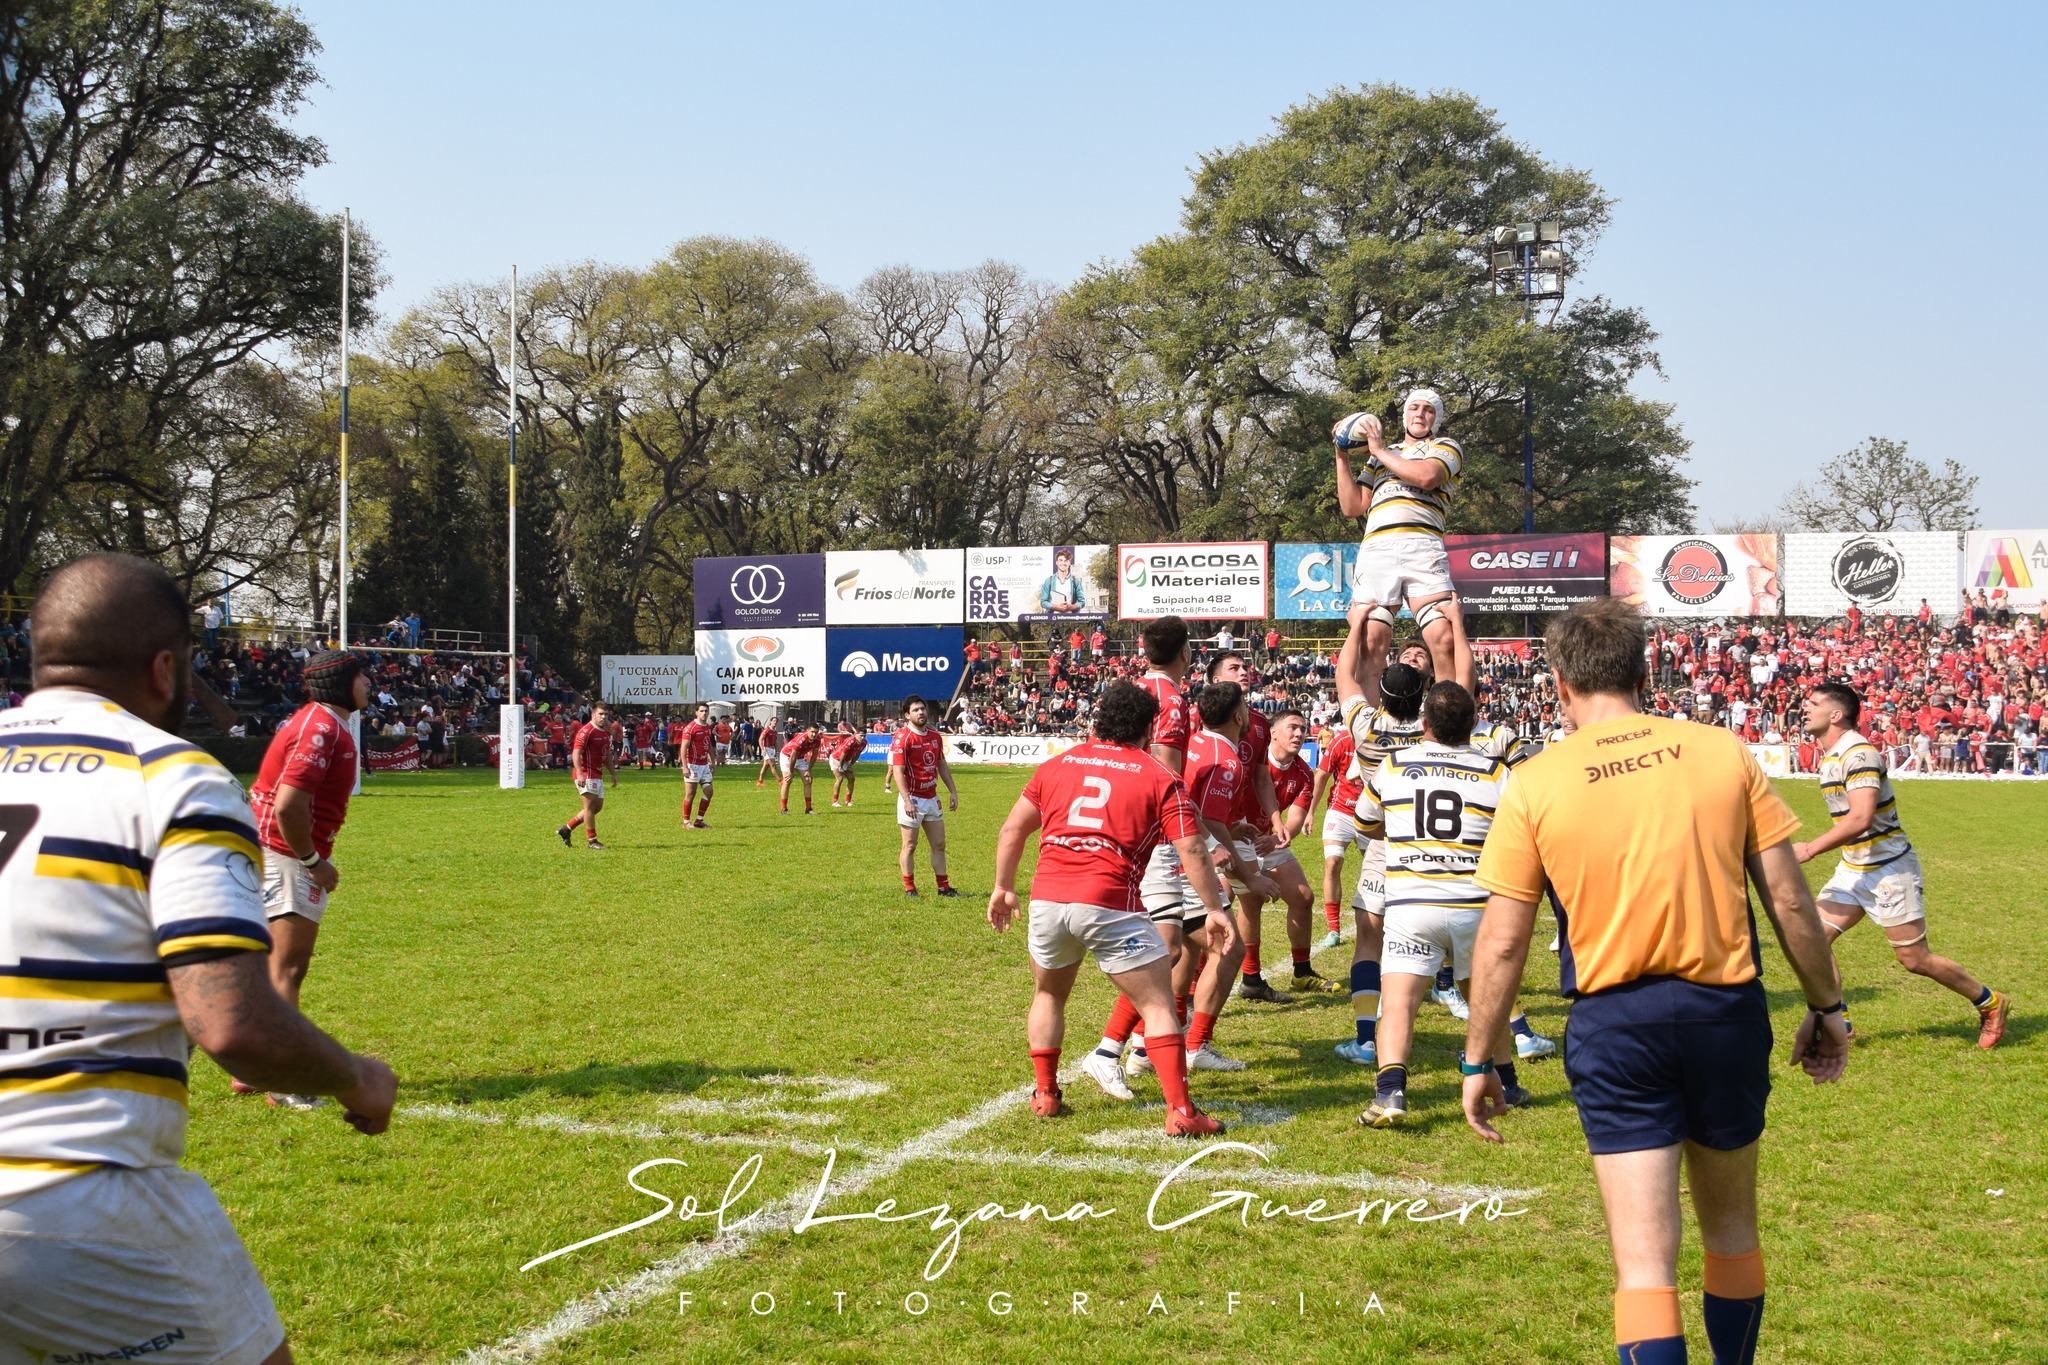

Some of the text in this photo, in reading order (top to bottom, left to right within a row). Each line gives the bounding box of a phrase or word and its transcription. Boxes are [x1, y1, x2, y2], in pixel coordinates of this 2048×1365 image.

[1673, 540, 1718, 554] PANIFICACION
[1150, 553, 1259, 569] GIACOSA
[1469, 550, 1551, 570] CASE
[1652, 564, 1735, 583] Las Delicias
[1840, 555, 1895, 586] Heller
[969, 575, 998, 590] CA
[1151, 573, 1260, 587] Materiales
[969, 590, 1009, 605] RRE
[1491, 586, 1536, 595] PUEBLE
[1152, 594, 1232, 606] Suipacha 482
[1298, 599, 1326, 612] LA
[1509, 596, 1522, 604] Km.
[1543, 596, 1566, 605] Parque
[735, 607, 782, 616] GOLOD Group
[969, 604, 1011, 619] RAS
[618, 664, 679, 676] TUCUMÁN
[882, 653, 950, 672] Macro
[716, 666, 805, 680] CAJA POPULAR
[641, 677, 657, 686] ES
[721, 683, 800, 695] DE AHORROS
[624, 687, 673, 696] AZUCAR
[1398, 737, 1424, 745] Mac
[1595, 728, 1653, 747] PROCER
[980, 740, 1040, 759] Tropez
[1584, 743, 1681, 784] DIRECTV
[1431, 766, 1480, 783] Macro
[1066, 775, 1112, 830] 2
[1414, 788, 1464, 840] 18
